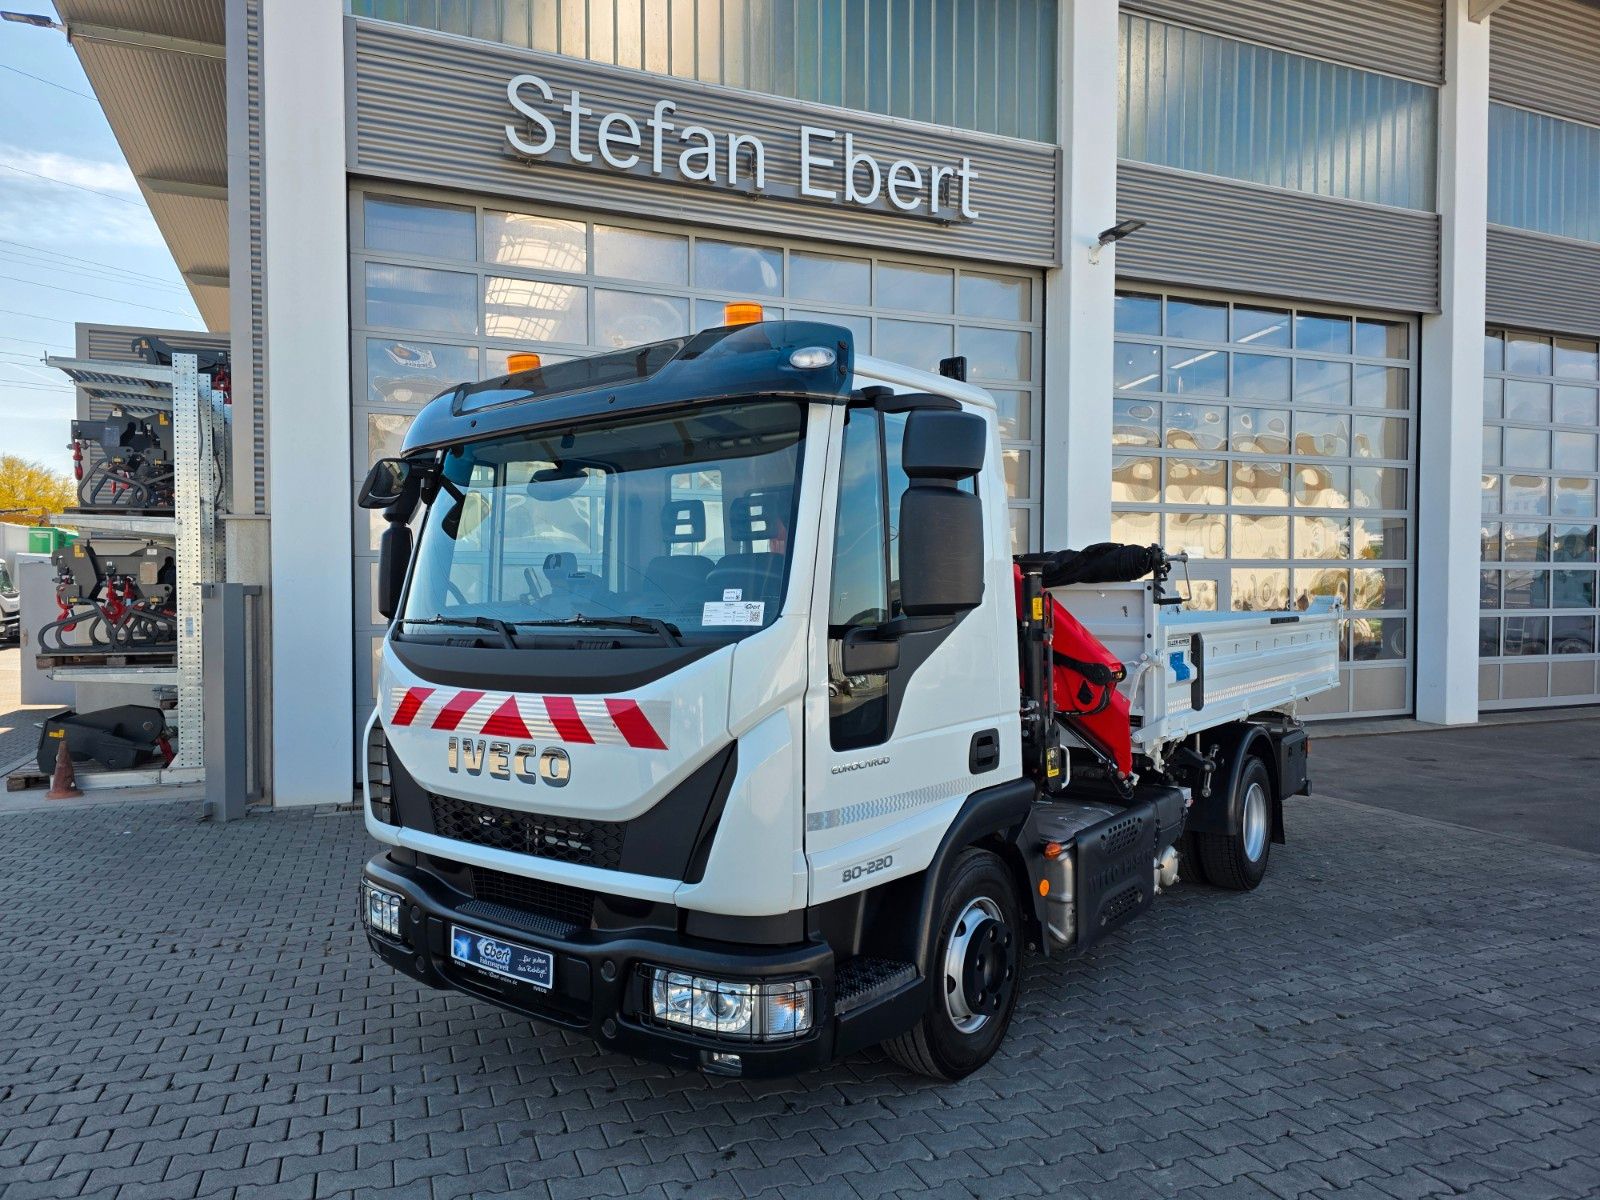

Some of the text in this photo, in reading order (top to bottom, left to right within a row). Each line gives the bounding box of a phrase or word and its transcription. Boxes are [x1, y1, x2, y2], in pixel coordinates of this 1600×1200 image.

[505, 74, 979, 219] Stefan Ebert
[448, 736, 571, 788] IVECO
[831, 756, 890, 775] EUROCARGO
[842, 855, 893, 883] 80-220
[483, 942, 510, 962] Ebert
